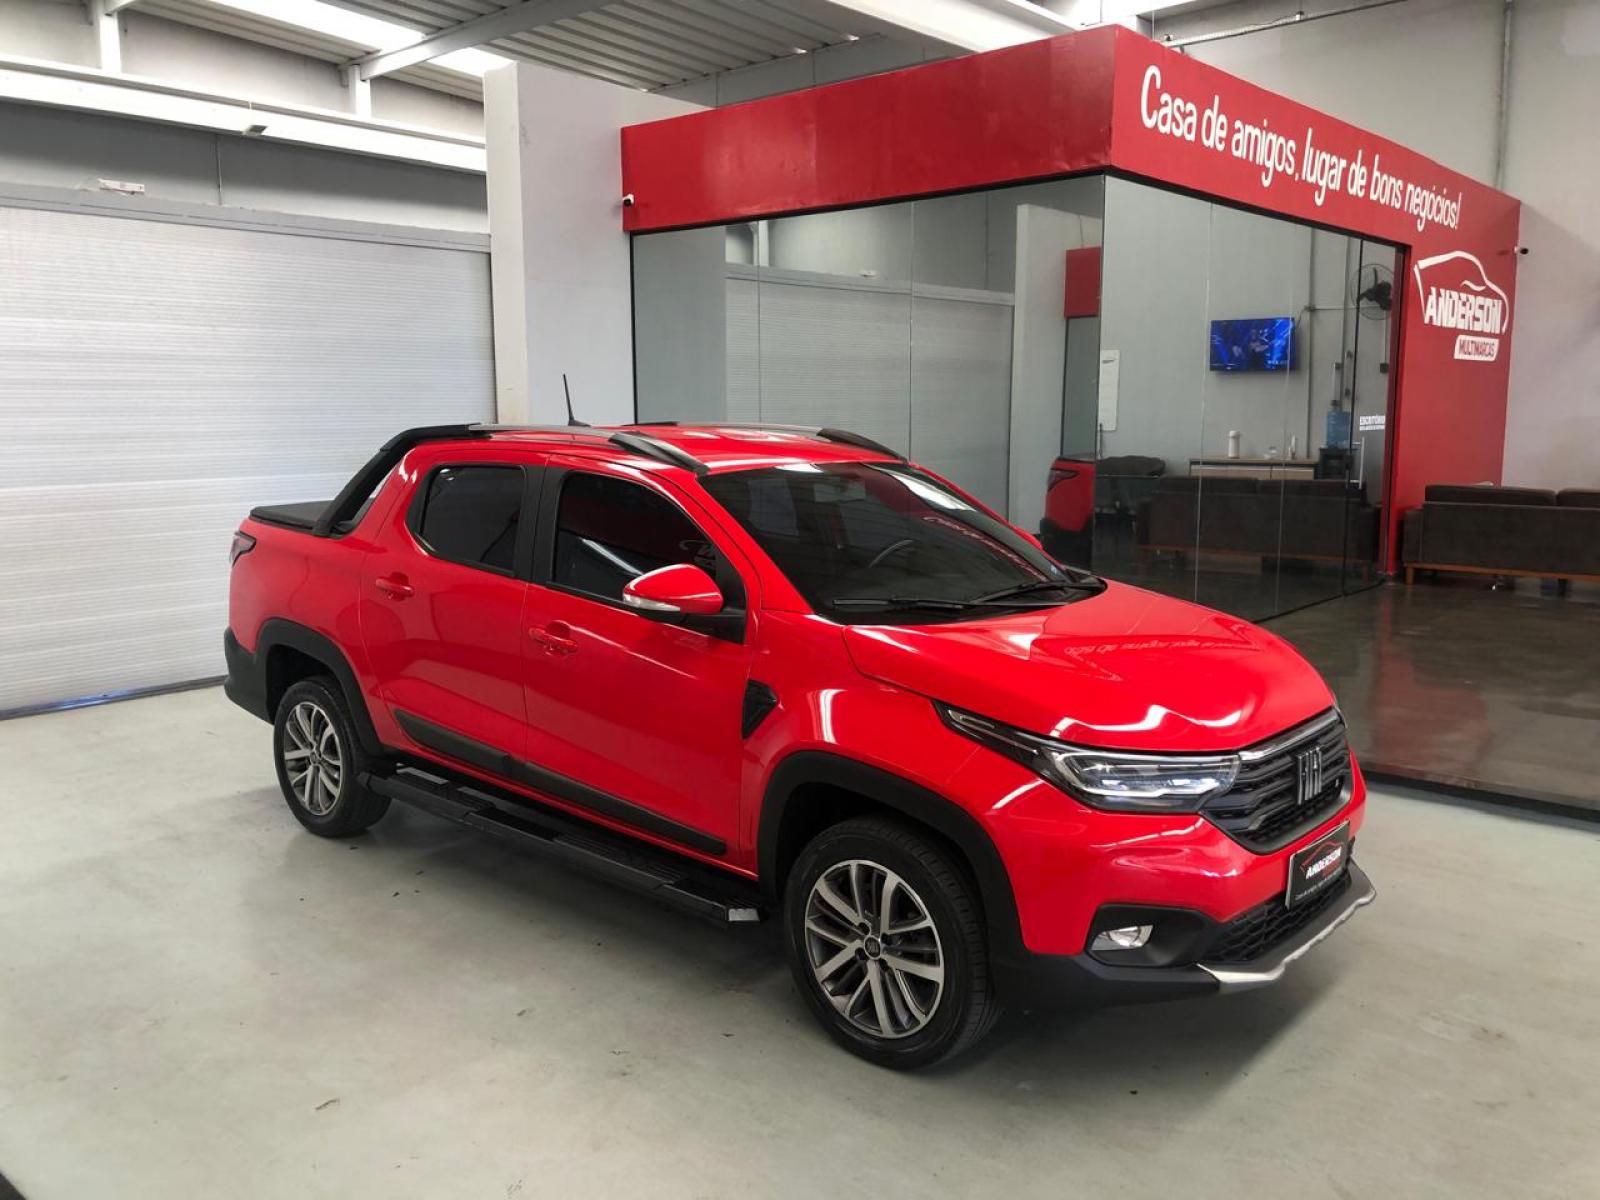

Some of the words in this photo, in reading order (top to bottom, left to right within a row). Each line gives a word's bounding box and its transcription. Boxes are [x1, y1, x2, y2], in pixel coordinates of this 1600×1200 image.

[1140, 64, 1198, 142] Casa
[1201, 95, 1228, 153] de
[1231, 119, 1300, 188] amigos,
[1301, 128, 1346, 206] lugar
[1346, 149, 1367, 197] de
[1370, 154, 1404, 210] bons
[1404, 183, 1462, 232] negócios!
[1424, 286, 1502, 335] ANDERSON
[1457, 338, 1496, 358] MULTIMARCAS
